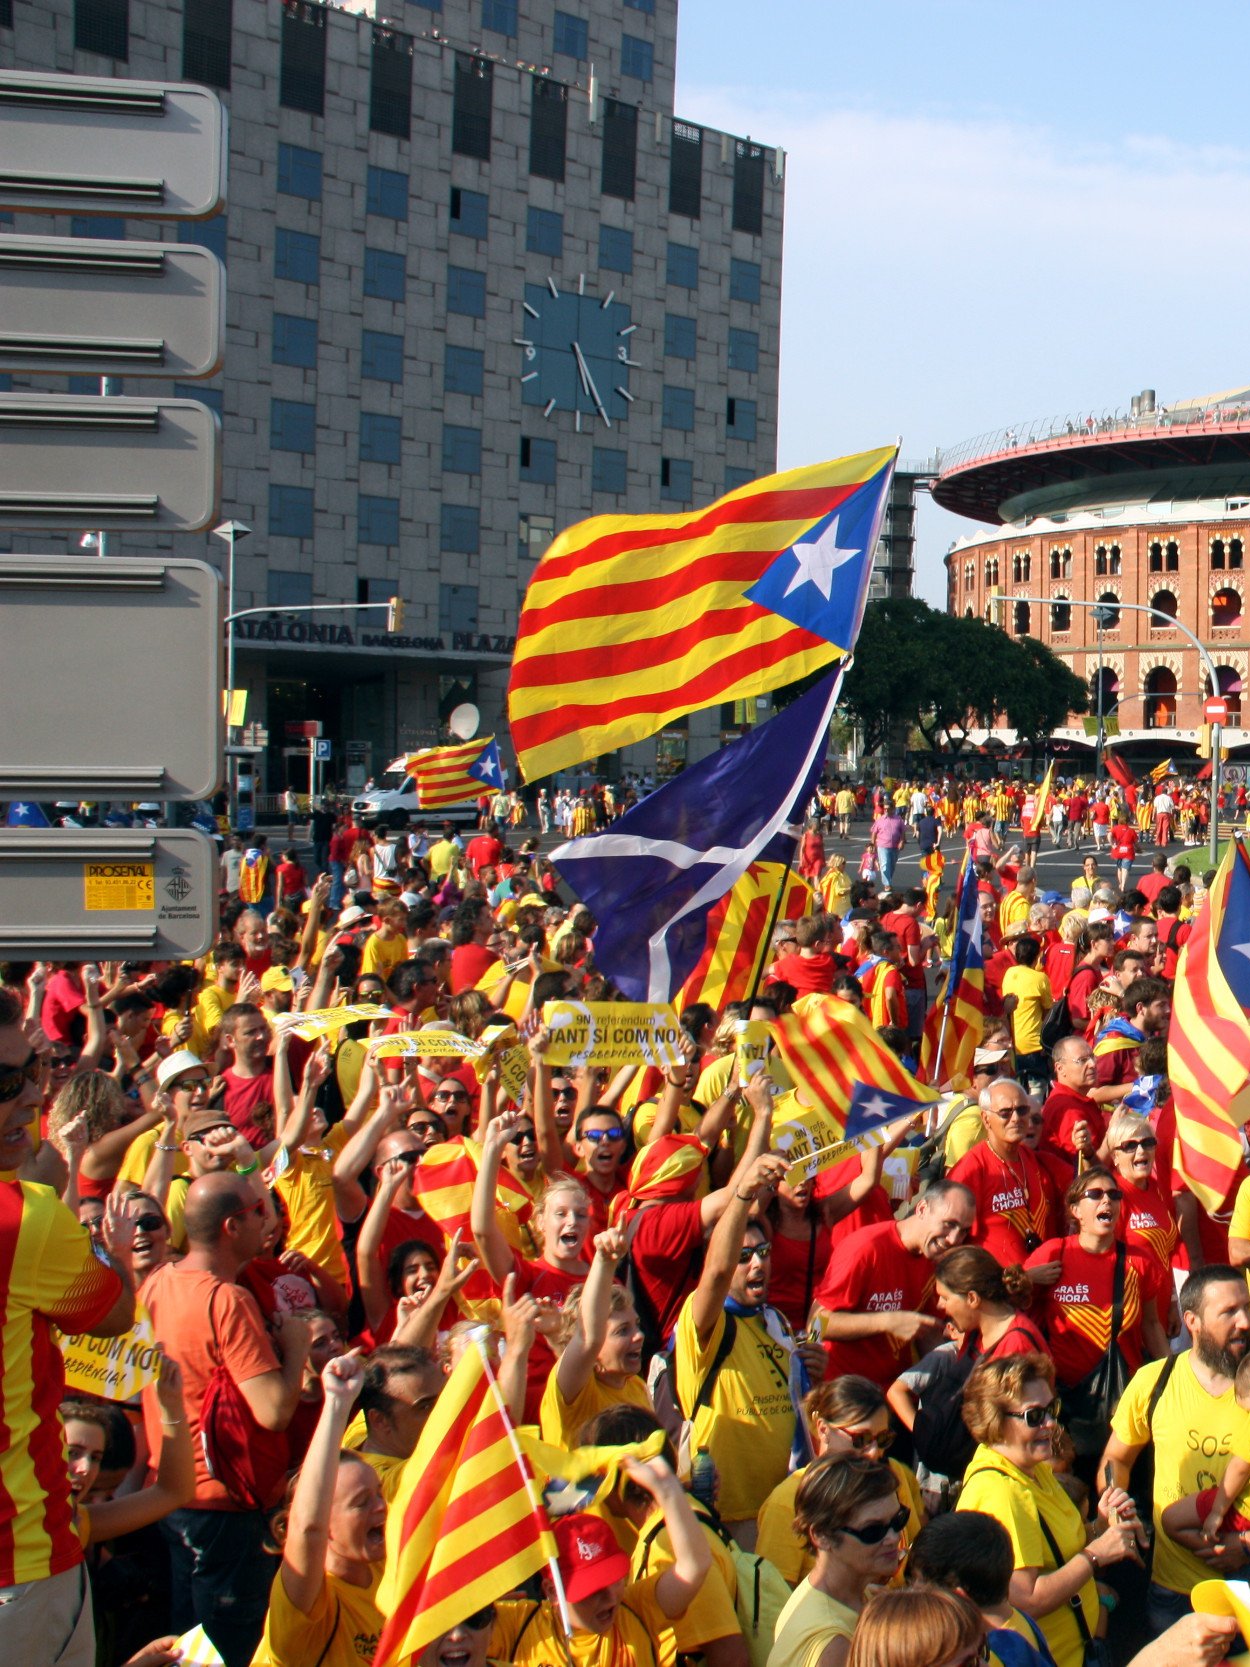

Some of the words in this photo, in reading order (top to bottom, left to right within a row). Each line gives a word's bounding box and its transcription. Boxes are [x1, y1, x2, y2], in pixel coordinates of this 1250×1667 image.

[526, 347, 536, 360] 9
[618, 347, 627, 360] 3
[224, 619, 354, 646] ATALONIA
[362, 633, 445, 650] BARCELONA
[318, 741, 327, 755] P
[613, 1028, 650, 1043] COM
[787, 1141, 810, 1160] ANT
[992, 1191, 1014, 1204] ARA
[992, 1199, 1028, 1212] L'HORA
[870, 1293, 893, 1302] ARA
[894, 1288, 903, 1301] ÉS
[1055, 1284, 1074, 1293] ARA
[1075, 1283, 1089, 1293] ÉS
[87, 1335, 127, 1361] COM
[125, 1342, 161, 1372] NO!
[64, 1357, 127, 1387] BEDIÈNCIA!
[1187, 1429, 1232, 1457] SOS
